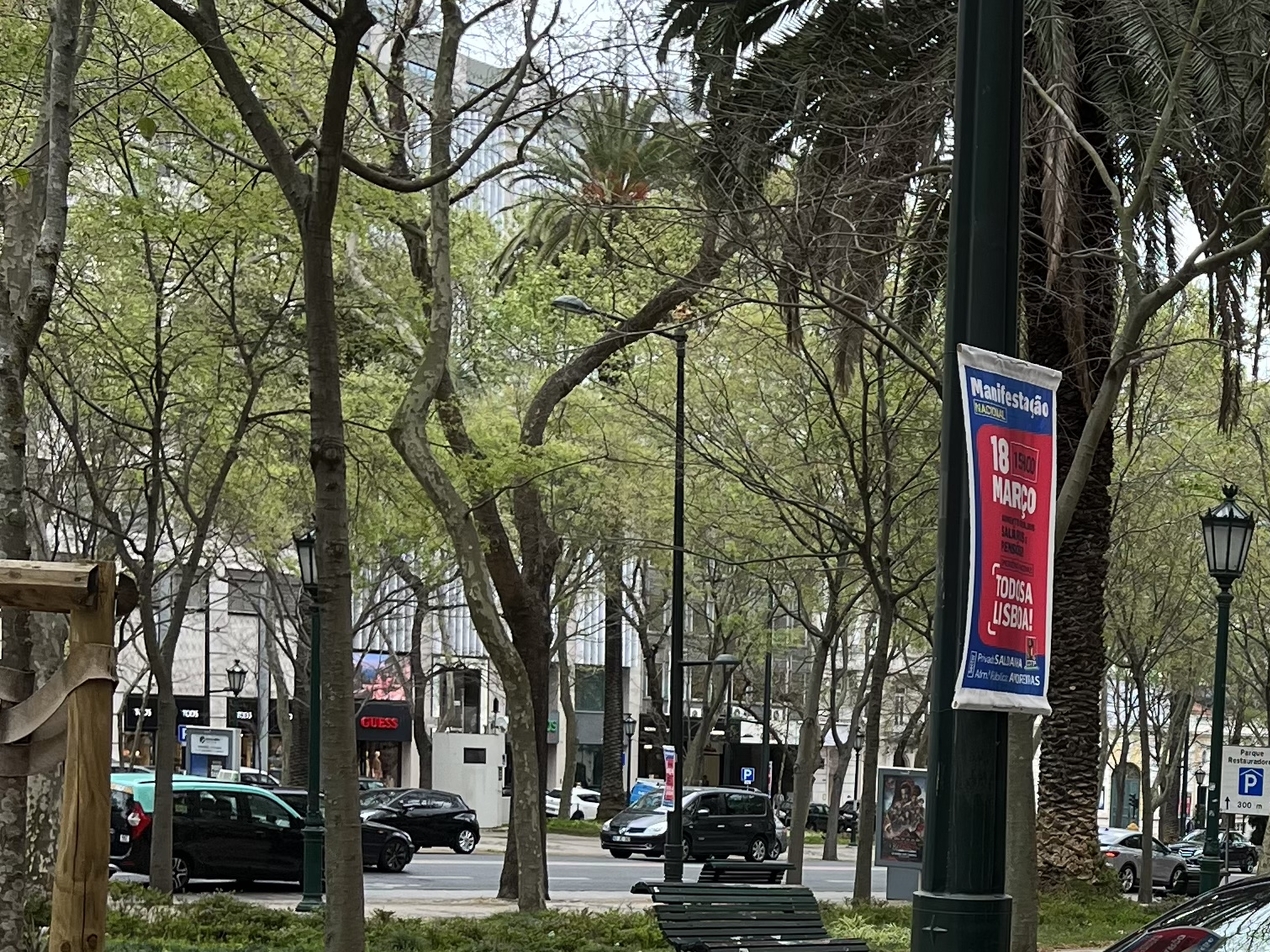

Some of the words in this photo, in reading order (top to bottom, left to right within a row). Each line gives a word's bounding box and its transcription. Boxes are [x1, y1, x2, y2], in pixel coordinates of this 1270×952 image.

[970, 377, 1049, 418] Manifestação
[990, 435, 1010, 474] 18
[992, 475, 1037, 519] MARÇO
[993, 601, 1033, 631] LISBOA!
[360, 716, 399, 729] GUESS
[1240, 749, 1265, 757] Parque
[743, 769, 752, 780] P
[1244, 773, 1258, 794] P
